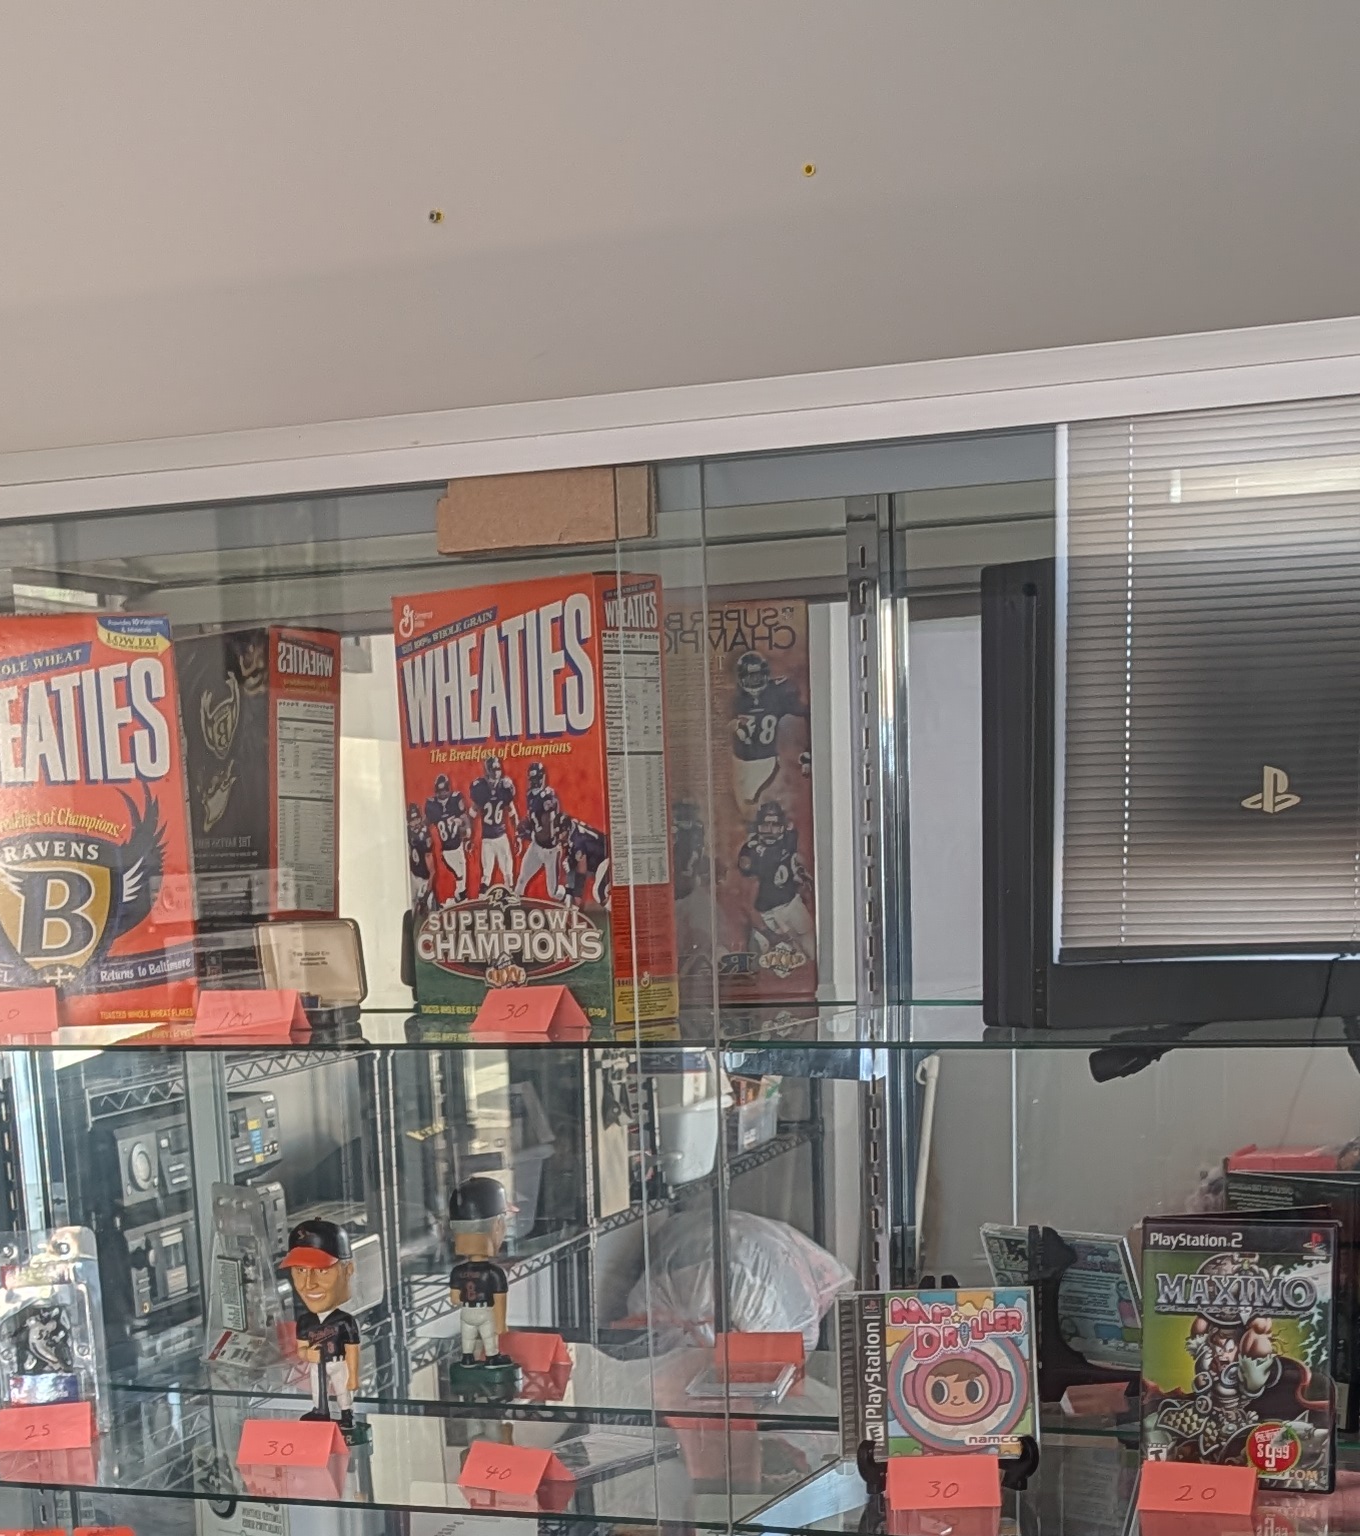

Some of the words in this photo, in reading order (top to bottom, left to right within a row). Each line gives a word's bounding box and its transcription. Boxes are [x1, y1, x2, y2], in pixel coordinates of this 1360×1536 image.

[463, 610, 494, 631] GRAIN
[604, 591, 658, 629] WHEATIES
[106, 635, 135, 647] LOW
[31, 648, 82, 670] WHEAT
[401, 592, 596, 748] WHEATIES
[430, 748, 447, 763] The
[449, 744, 497, 761] Breakfast
[498, 745, 508, 760] of
[510, 740, 573, 758] Champions
[43, 808, 56, 826] of
[57, 807, 126, 838] Champions!
[482, 801, 504, 826] 26
[3, 840, 100, 862] RAVENS
[427, 910, 505, 931] SUPER
[509, 908, 588, 930] BOWL
[416, 928, 604, 963] CHAMPIONS
[100, 967, 134, 983] Returns
[138, 966, 147, 979] to
[148, 956, 192, 977] Baltimore
[216, 1011, 253, 1030] 100
[498, 1003, 529, 1021] 30
[1155, 1272, 1318, 1309] MAXIMO
[864, 1321, 883, 1419] PlayStation
[24, 1423, 51, 1440] 25
[968, 1435, 1019, 1445] namco
[263, 1440, 295, 1458] 30
[485, 1464, 512, 1481] 40
[927, 1480, 960, 1499] 30
[1174, 1485, 1217, 1501] 20
